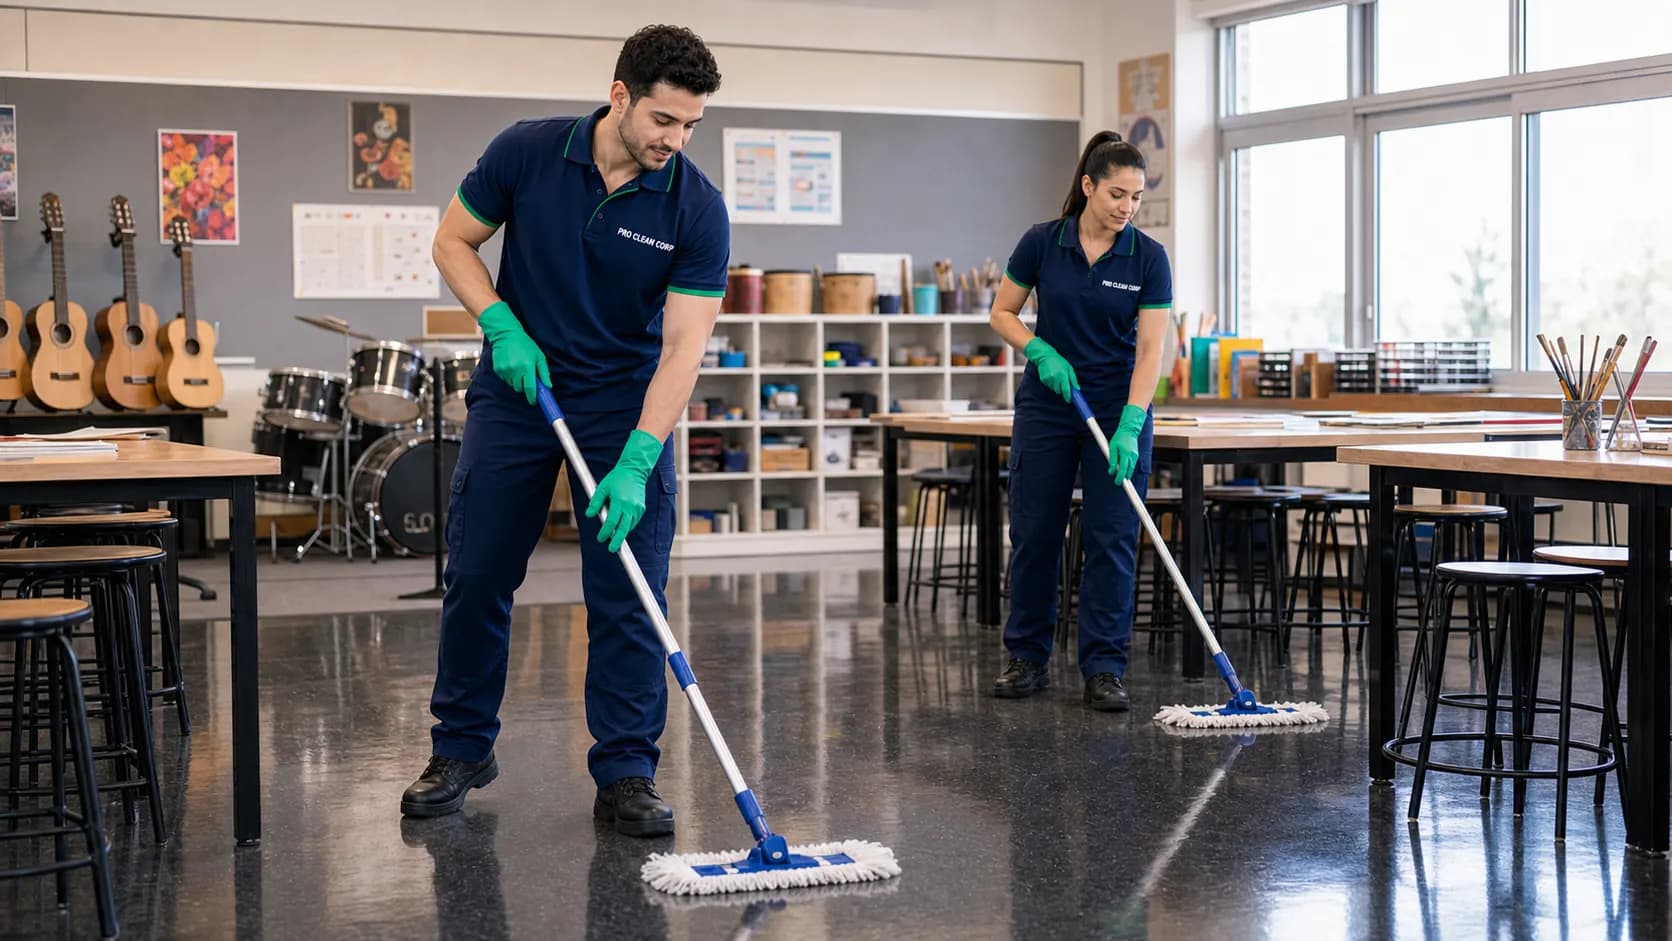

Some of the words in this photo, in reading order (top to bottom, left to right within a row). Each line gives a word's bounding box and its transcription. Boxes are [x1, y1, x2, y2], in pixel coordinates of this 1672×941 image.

[617, 227, 632, 239] PRO
[632, 233, 656, 246] CLEAN
[655, 240, 675, 252] CORP
